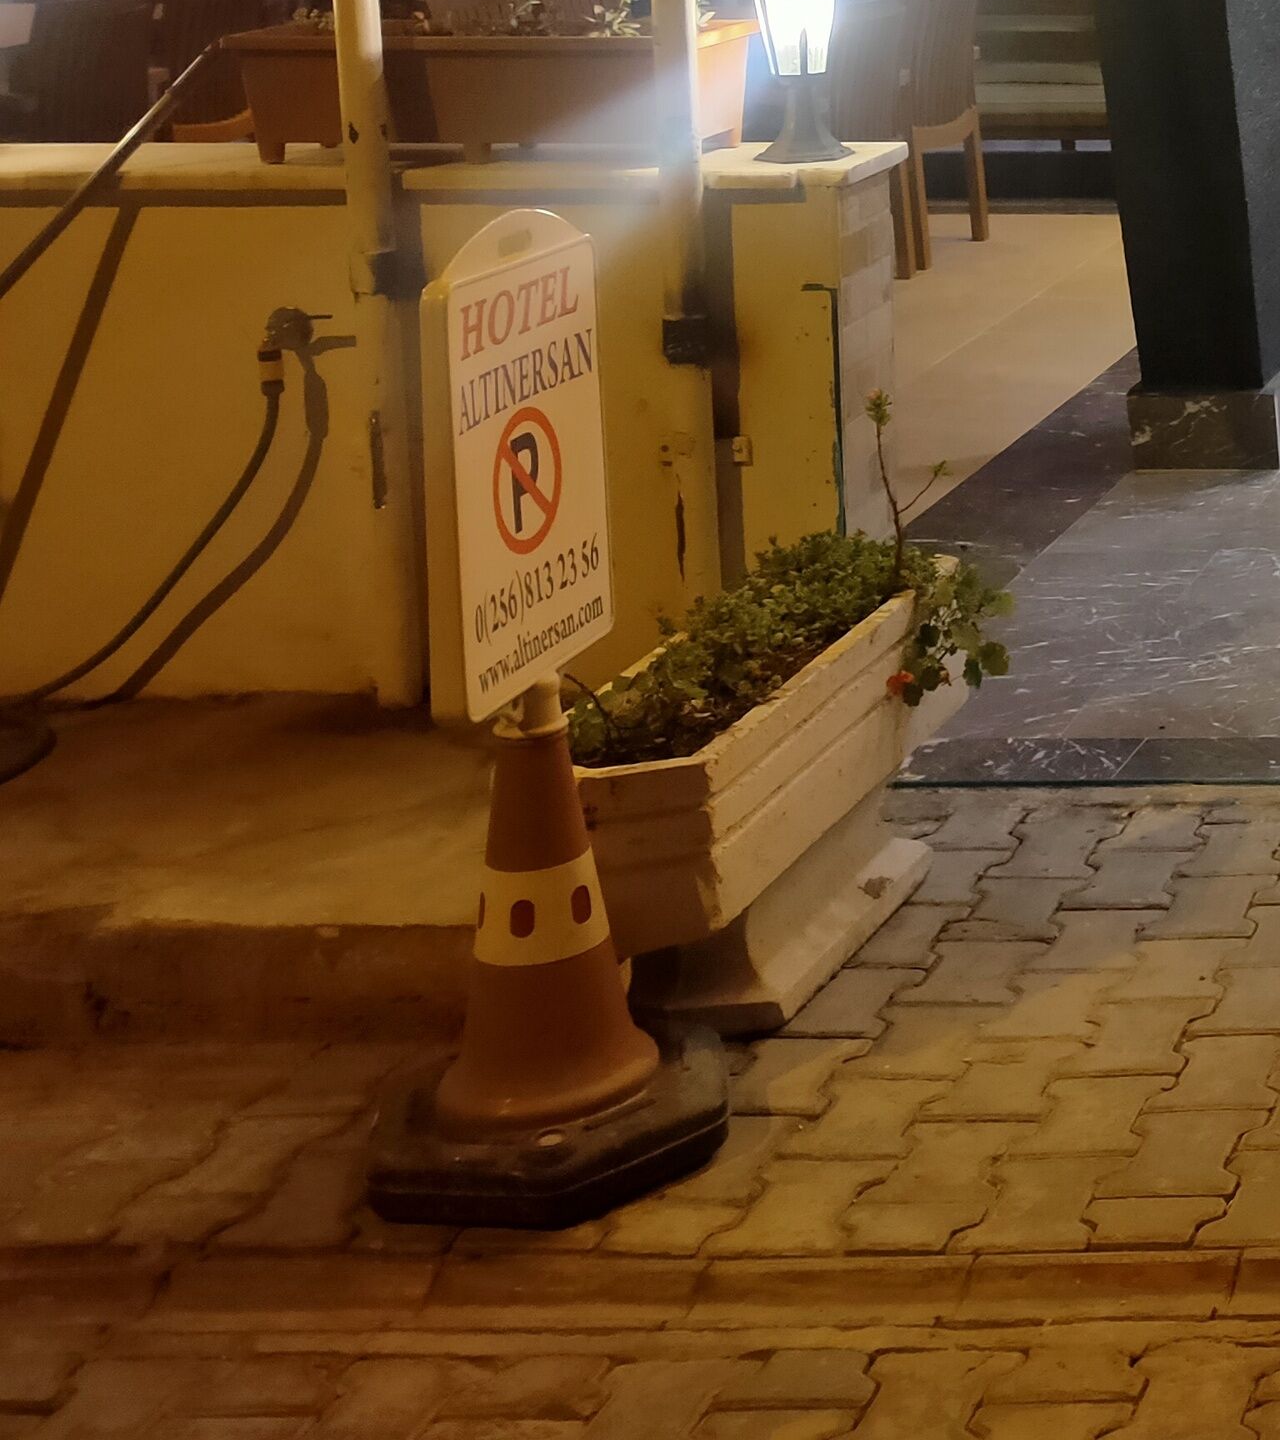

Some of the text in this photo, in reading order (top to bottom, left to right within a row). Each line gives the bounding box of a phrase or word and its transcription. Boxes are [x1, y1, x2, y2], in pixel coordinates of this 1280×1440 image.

[460, 265, 580, 362] HOTEL
[458, 327, 593, 437] ALTINERSAN
[477, 595, 605, 695] www.altinersan.com
